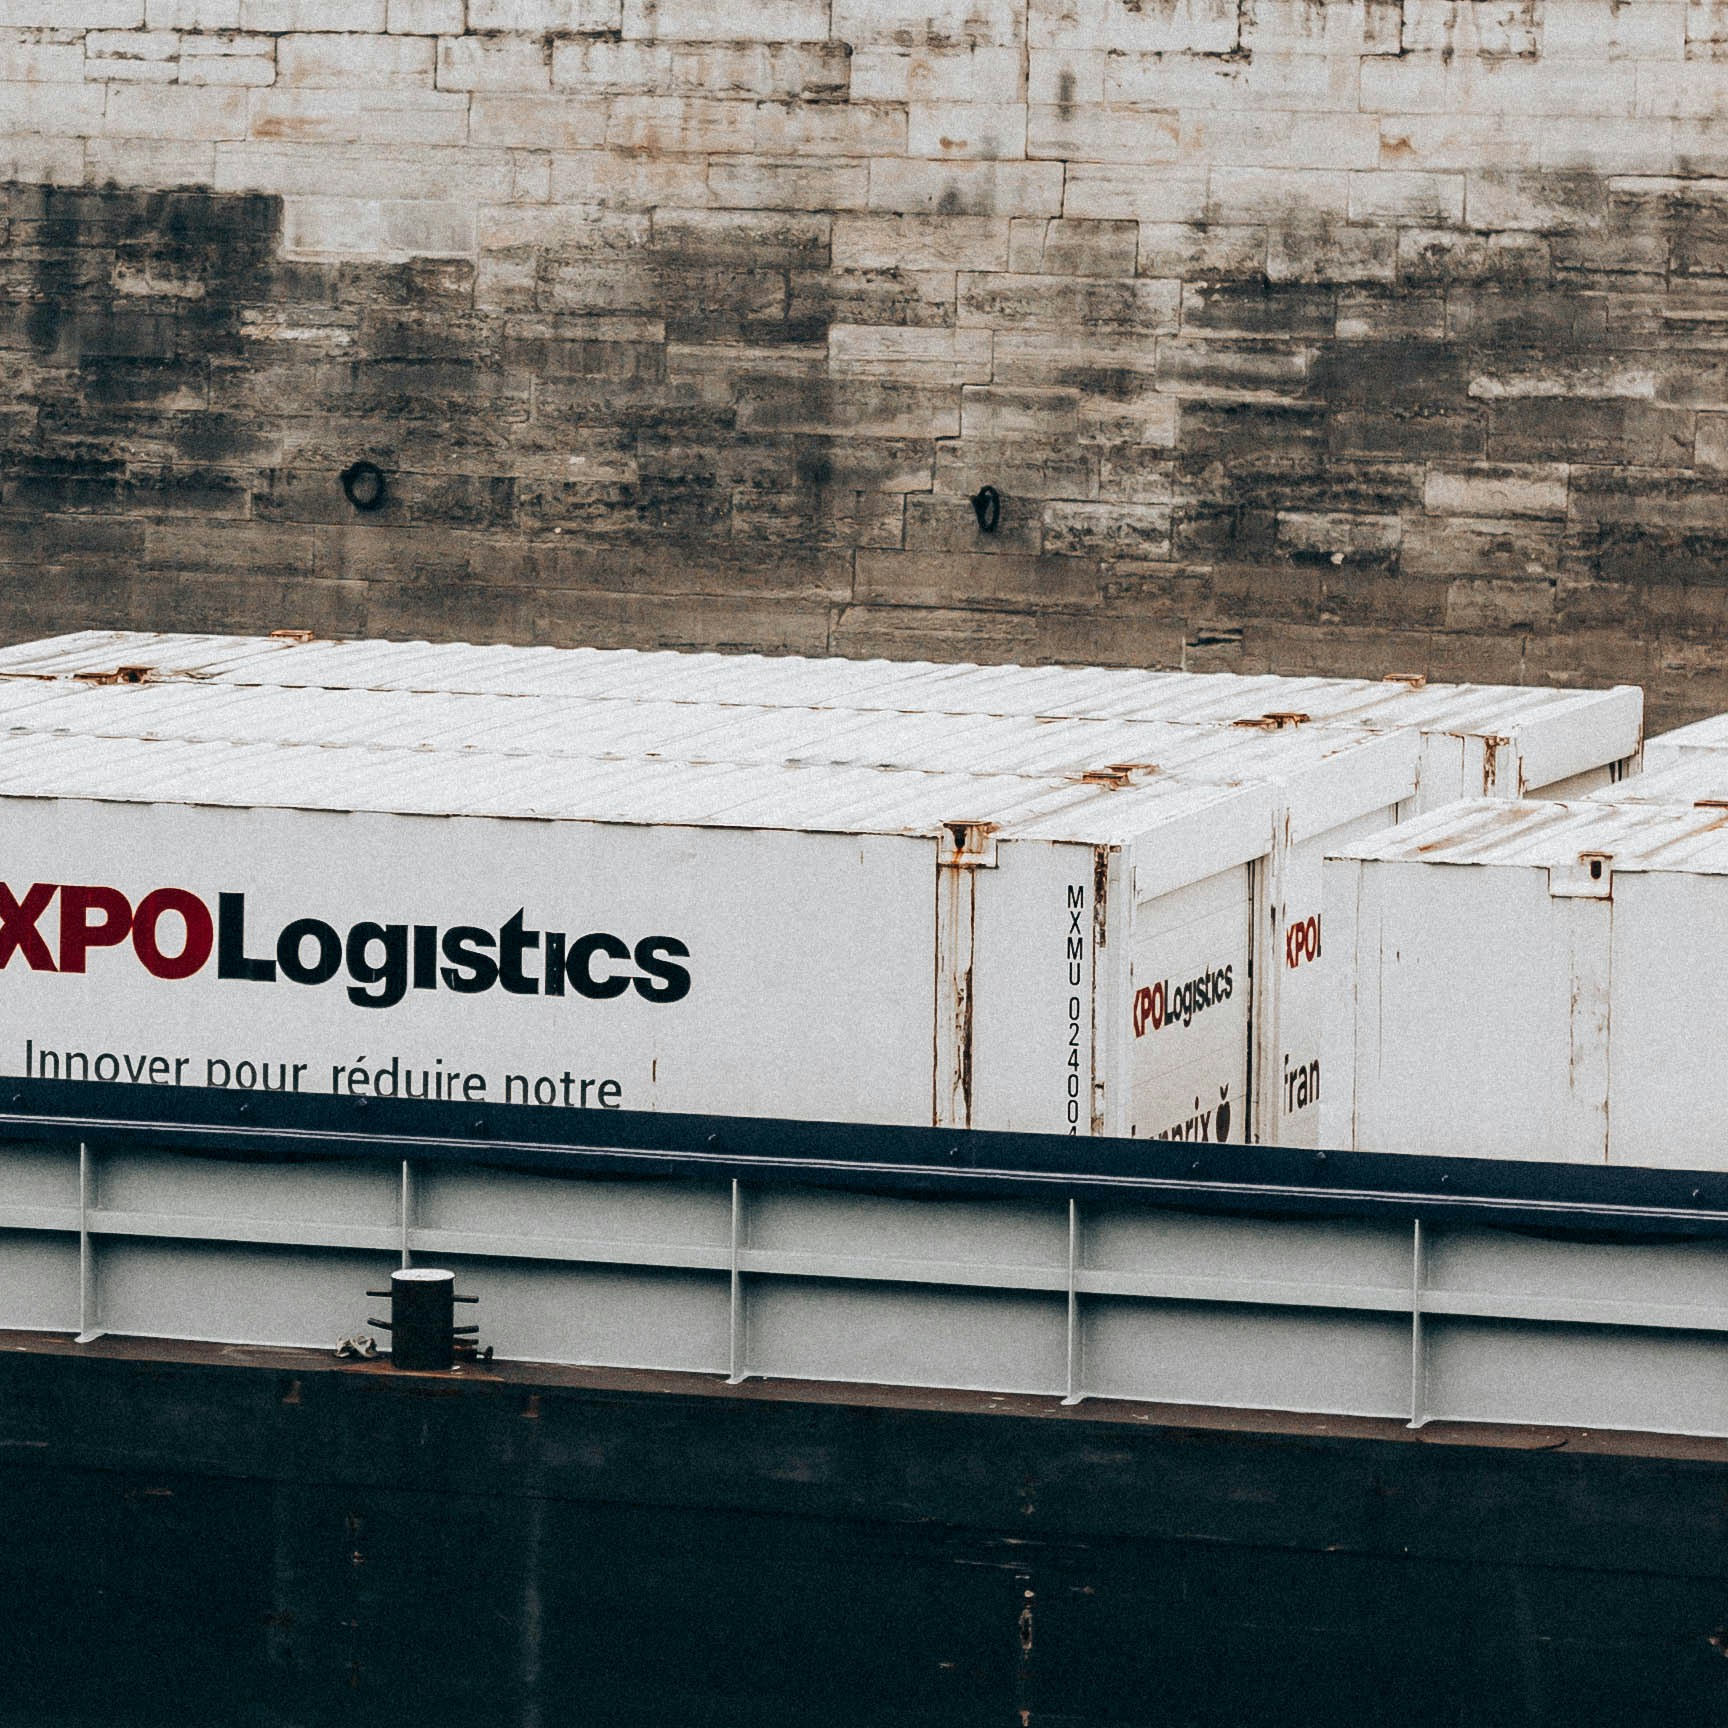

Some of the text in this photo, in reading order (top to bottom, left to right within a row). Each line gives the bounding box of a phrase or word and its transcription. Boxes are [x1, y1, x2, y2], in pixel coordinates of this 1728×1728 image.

[1067, 884, 1084, 986] MXMU
[26, 1039, 622, 1109] Innover pour réduire notre
